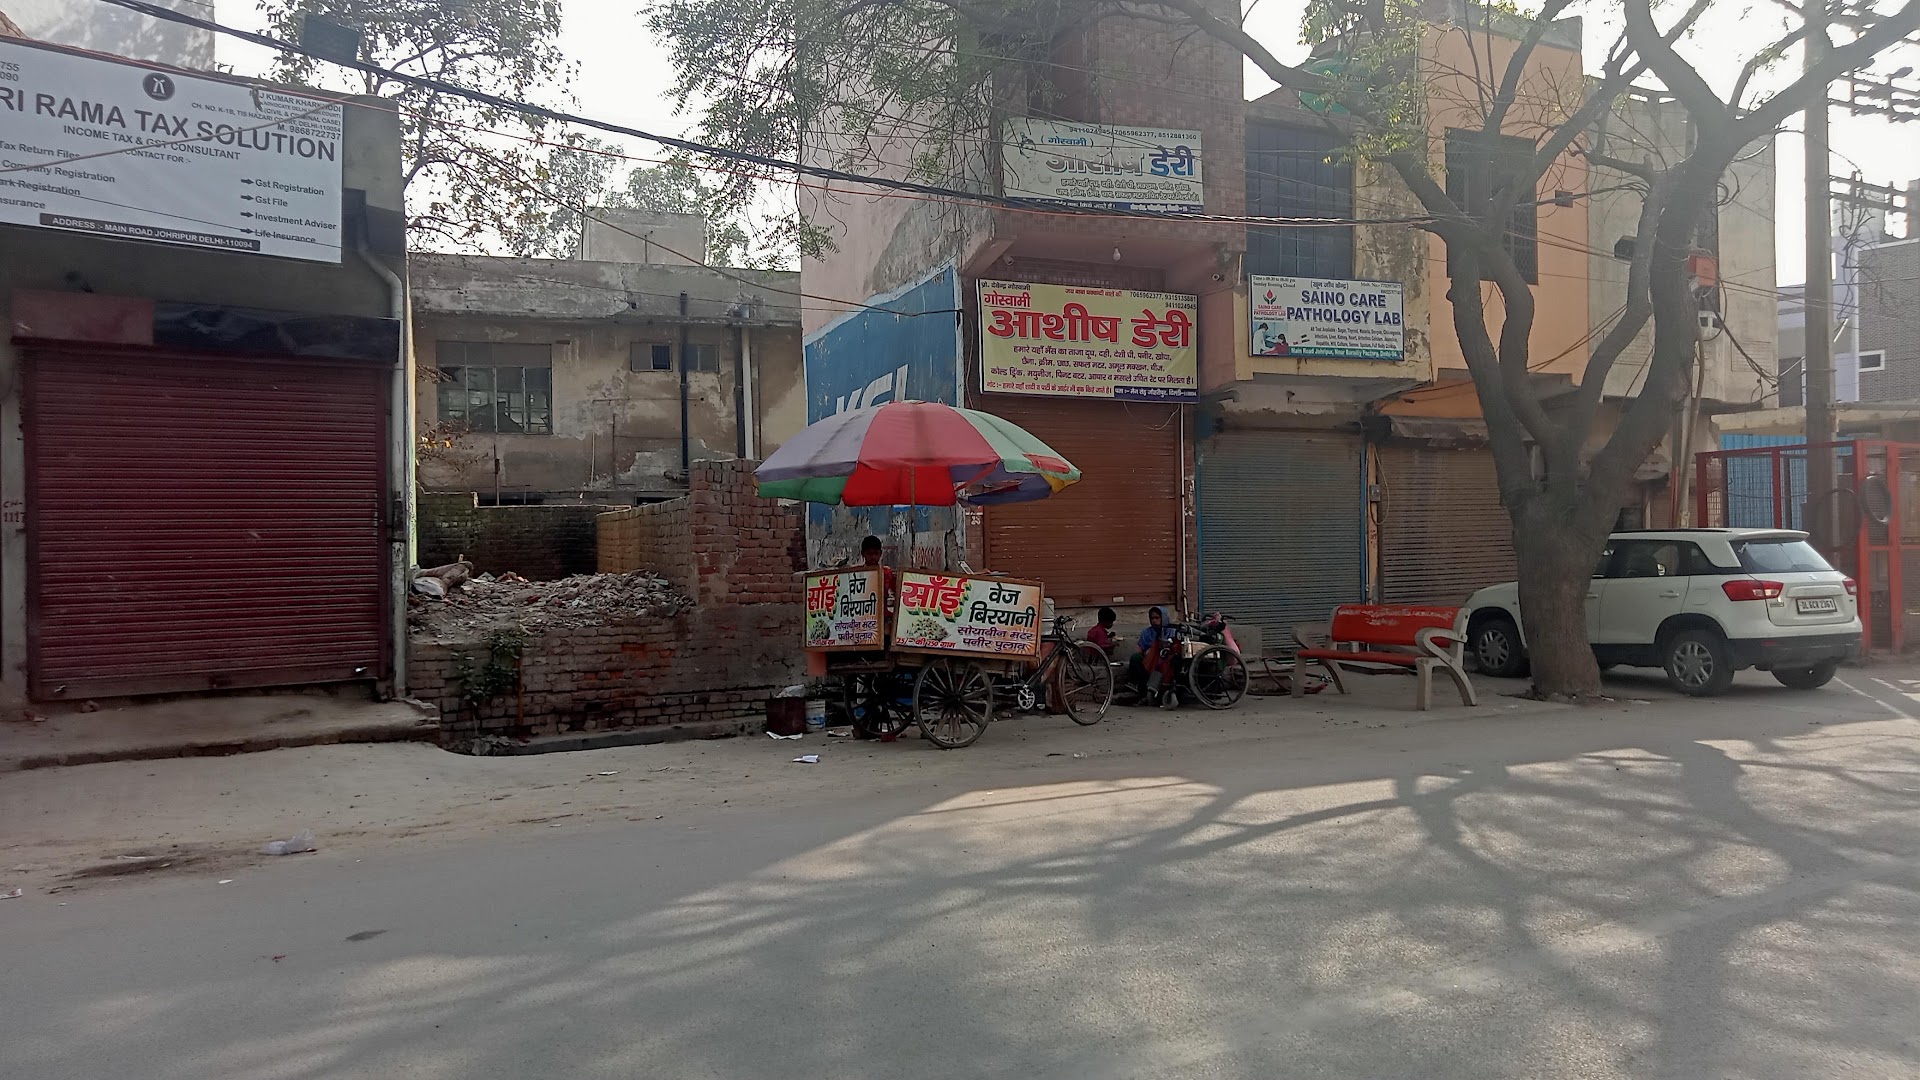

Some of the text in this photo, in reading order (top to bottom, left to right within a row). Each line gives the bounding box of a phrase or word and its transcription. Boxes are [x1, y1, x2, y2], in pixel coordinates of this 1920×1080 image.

[266, 93, 295, 104] KUMAR
[248, 112, 273, 122] HAZARI
[36, 93, 126, 128] RAMA
[134, 109, 189, 139] TAX
[196, 120, 335, 162] SOLUTION
[277, 123, 341, 141] M. 9868722737
[0, 141, 16, 151] Tax
[19, 143, 55, 157] Return
[63, 125, 109, 140] INCOME
[112, 132, 133, 144] TAX
[135, 136, 144, 146] &
[170, 141, 241, 161] CONSULTANT
[124, 149, 184, 163] CONTACT FOR
[1148, 144, 1197, 177] डेरी
[54, 166, 116, 183] Registration
[18, 179, 81, 196] Registration
[255, 178, 325, 196] Gst Registration
[255, 195, 288, 207] Gst File
[255, 212, 337, 230] Investment Adviser
[52, 217, 253, 248] ADDRESS MAIN ROAD JOHRIPUR DELHI-110094
[254, 228, 316, 243] Life Insurance
[983, 290, 1031, 308] गोस्वामी
[1301, 290, 1386, 307] SAINO CARE
[1286, 306, 1401, 325] PATHOLOGY LAB
[987, 302, 1193, 348] आशीष डेरी
[1013, 344, 1030, 354] हमारे
[1068, 348, 1084, 356] ताजा
[990, 366, 1008, 376] कोल्ड
[848, 572, 867, 595] वेज
[988, 582, 1021, 606] वेज
[840, 592, 877, 618] बिरयानी
[968, 600, 1037, 628] बिरयानी
[957, 624, 1035, 640] सोयाबीन मटर
[962, 636, 1028, 652] पनीर पुलाव
